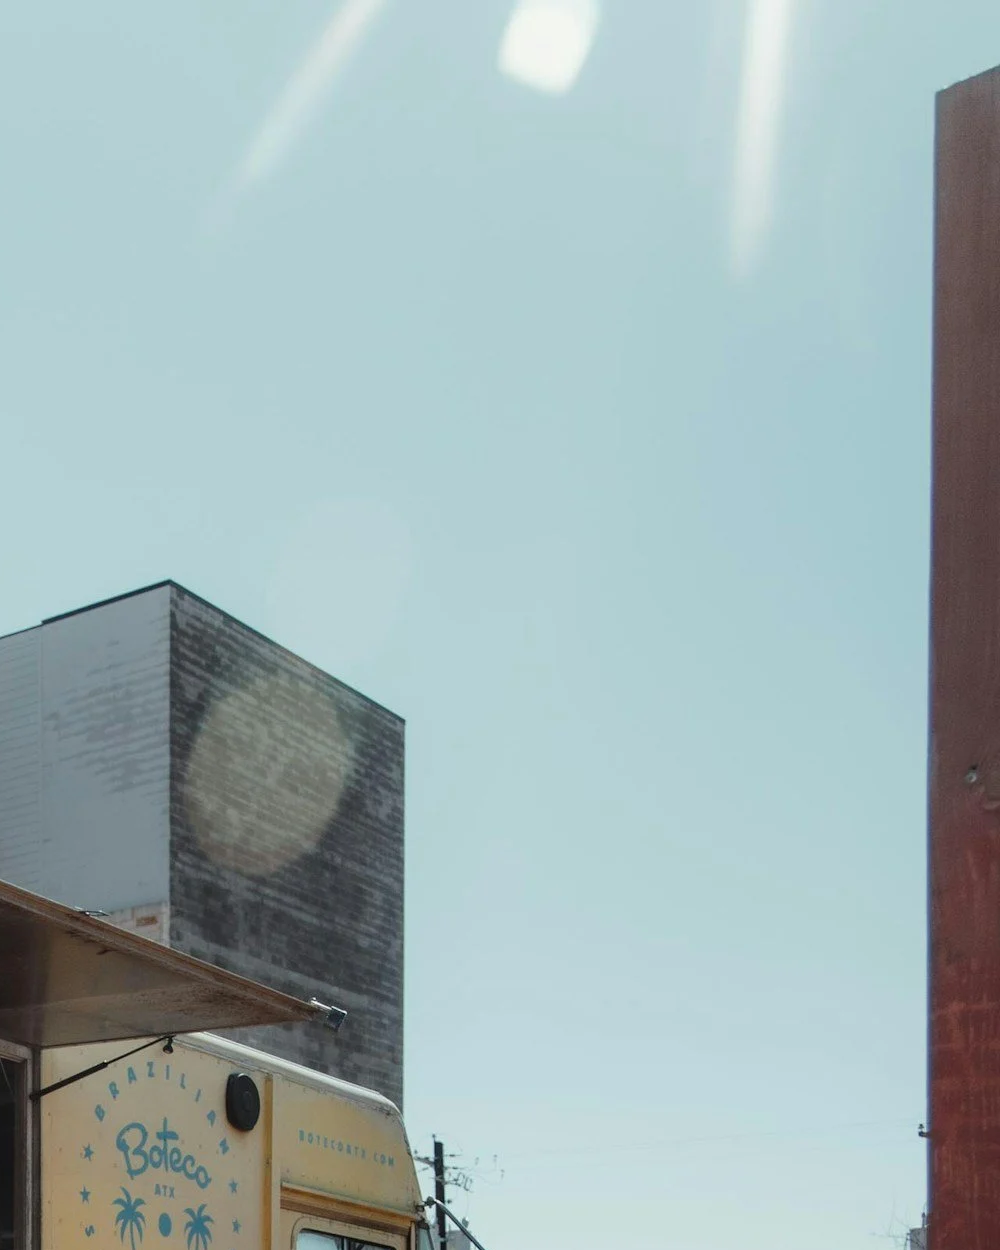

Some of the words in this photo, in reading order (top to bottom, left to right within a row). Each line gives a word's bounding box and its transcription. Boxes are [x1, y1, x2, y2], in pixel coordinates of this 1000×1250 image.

[95, 1061, 230, 1155] BRAZILIAN
[116, 1117, 212, 1189] Boteco
[154, 1183, 176, 1199] ATX
